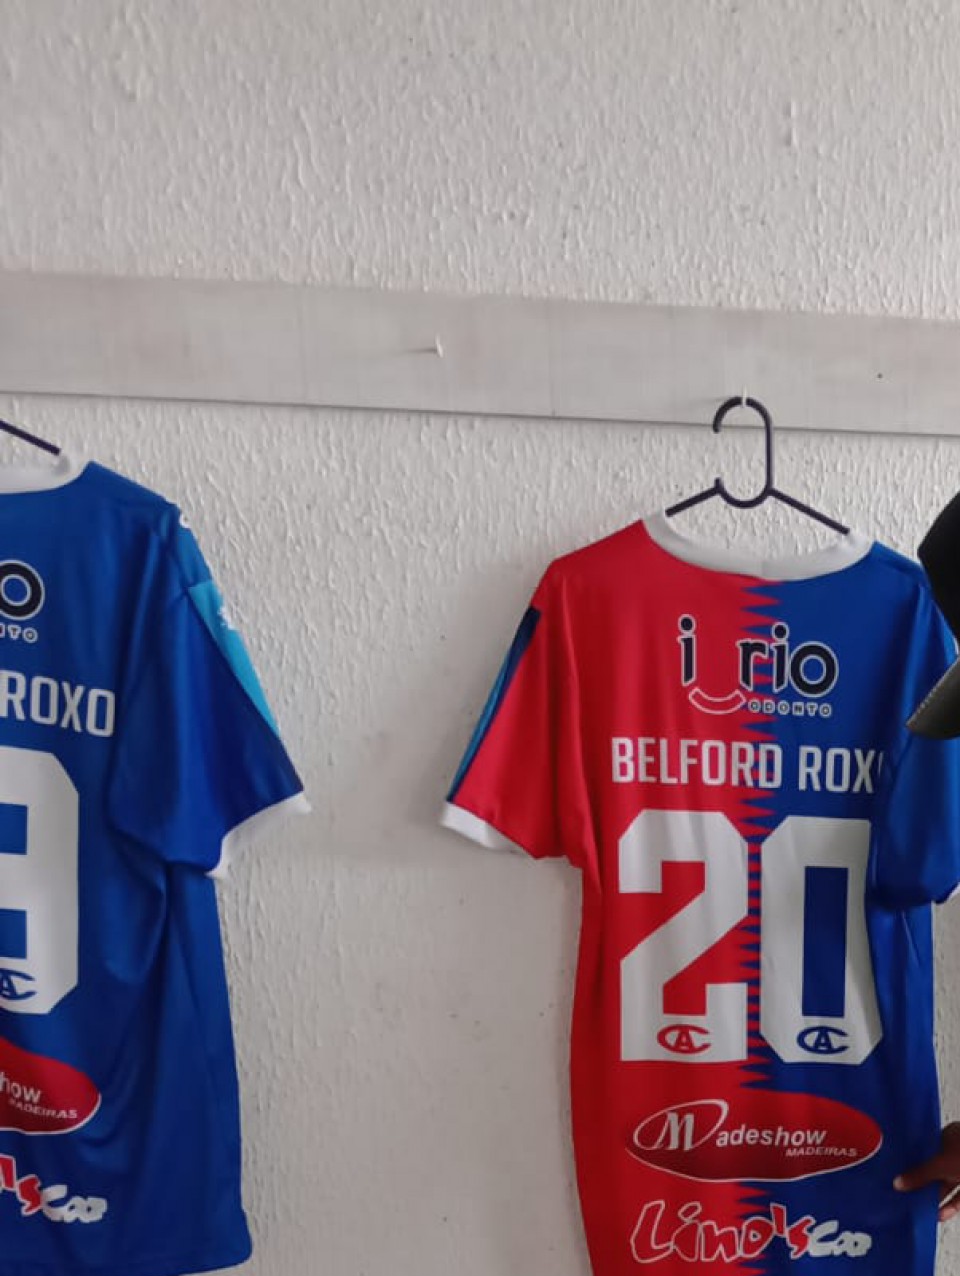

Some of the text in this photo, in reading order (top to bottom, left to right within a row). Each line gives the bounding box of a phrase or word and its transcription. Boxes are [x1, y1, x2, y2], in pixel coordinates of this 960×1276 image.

[0, 669, 116, 738] ROXO
[747, 698, 833, 718] ODONTO
[611, 736, 884, 794] BELFORD ROX
[618, 808, 884, 1065] 20
[651, 1110, 829, 1152] Madeshow
[785, 1146, 859, 1158] MADEIRAS
